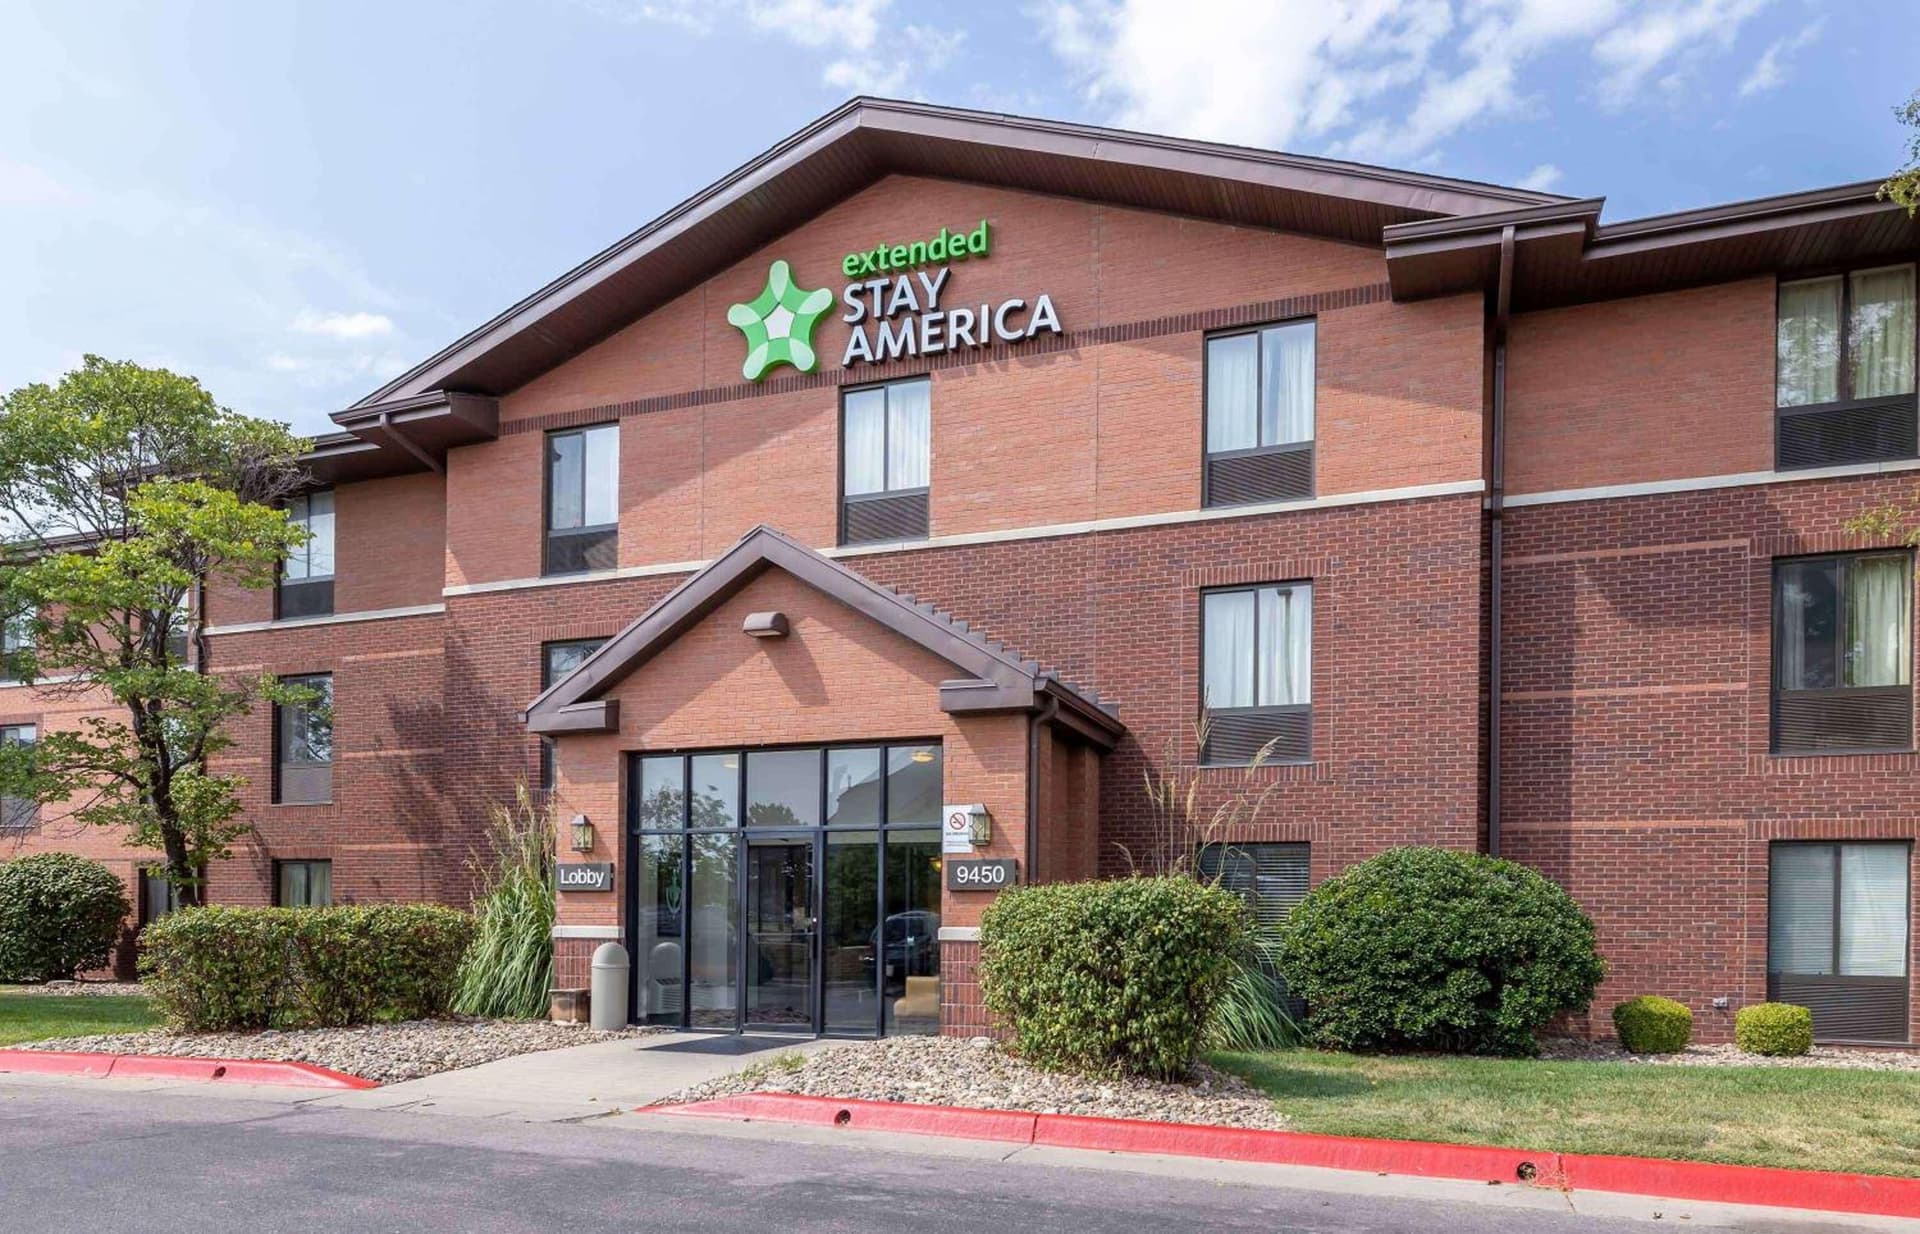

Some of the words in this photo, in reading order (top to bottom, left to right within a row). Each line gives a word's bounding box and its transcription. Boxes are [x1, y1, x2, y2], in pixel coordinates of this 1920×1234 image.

[842, 219, 989, 276] extended
[842, 267, 950, 324] STAY
[842, 294, 1062, 367] AMERICA
[560, 868, 604, 887] Lobby
[956, 865, 1005, 883] 9450
